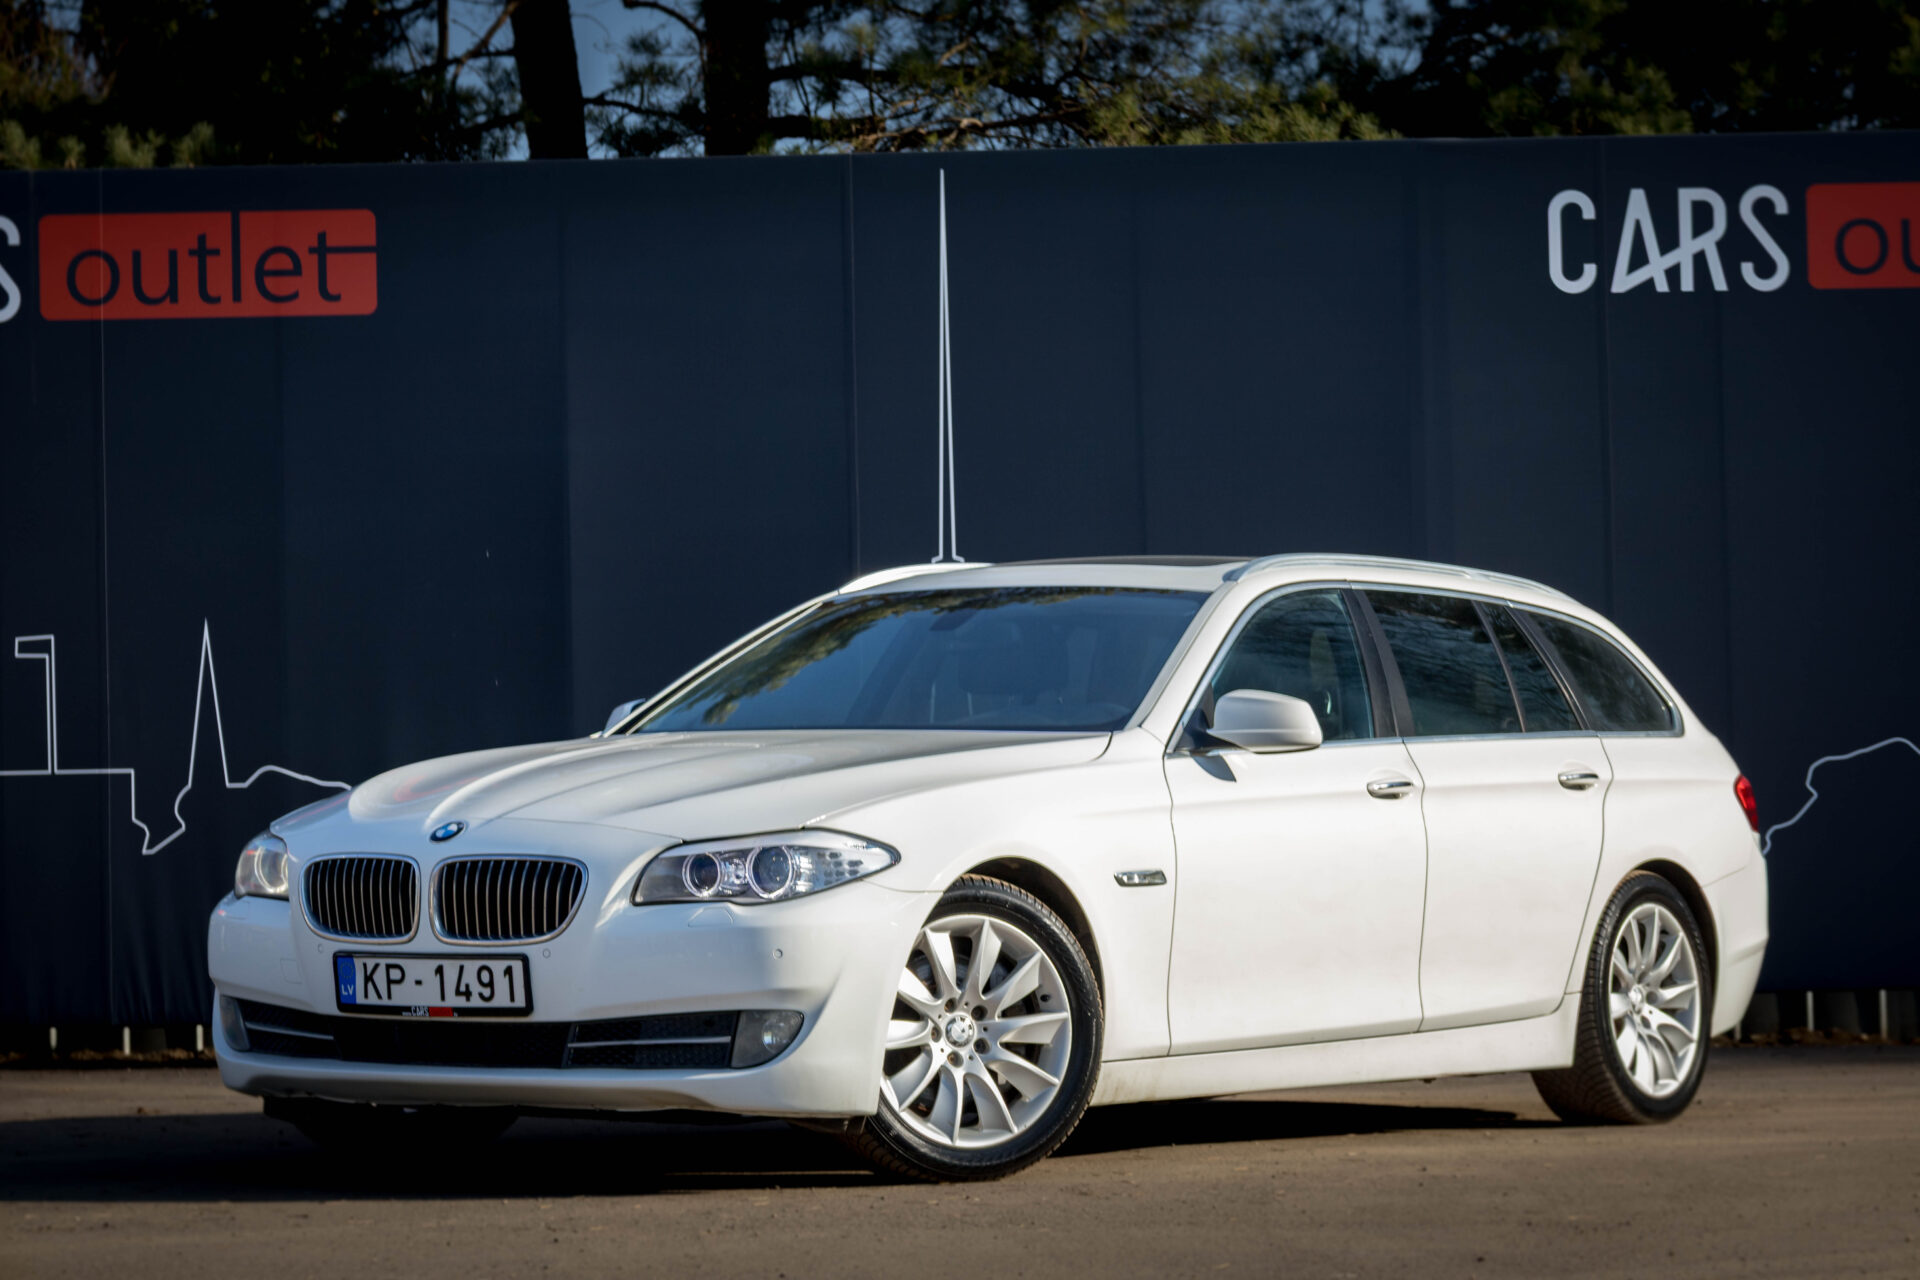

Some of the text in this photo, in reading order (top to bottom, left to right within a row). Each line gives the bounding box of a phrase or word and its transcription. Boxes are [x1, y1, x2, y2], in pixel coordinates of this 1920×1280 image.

[65, 211, 377, 307] outlet
[1547, 184, 1790, 294] CARS
[341, 983, 354, 996] LV
